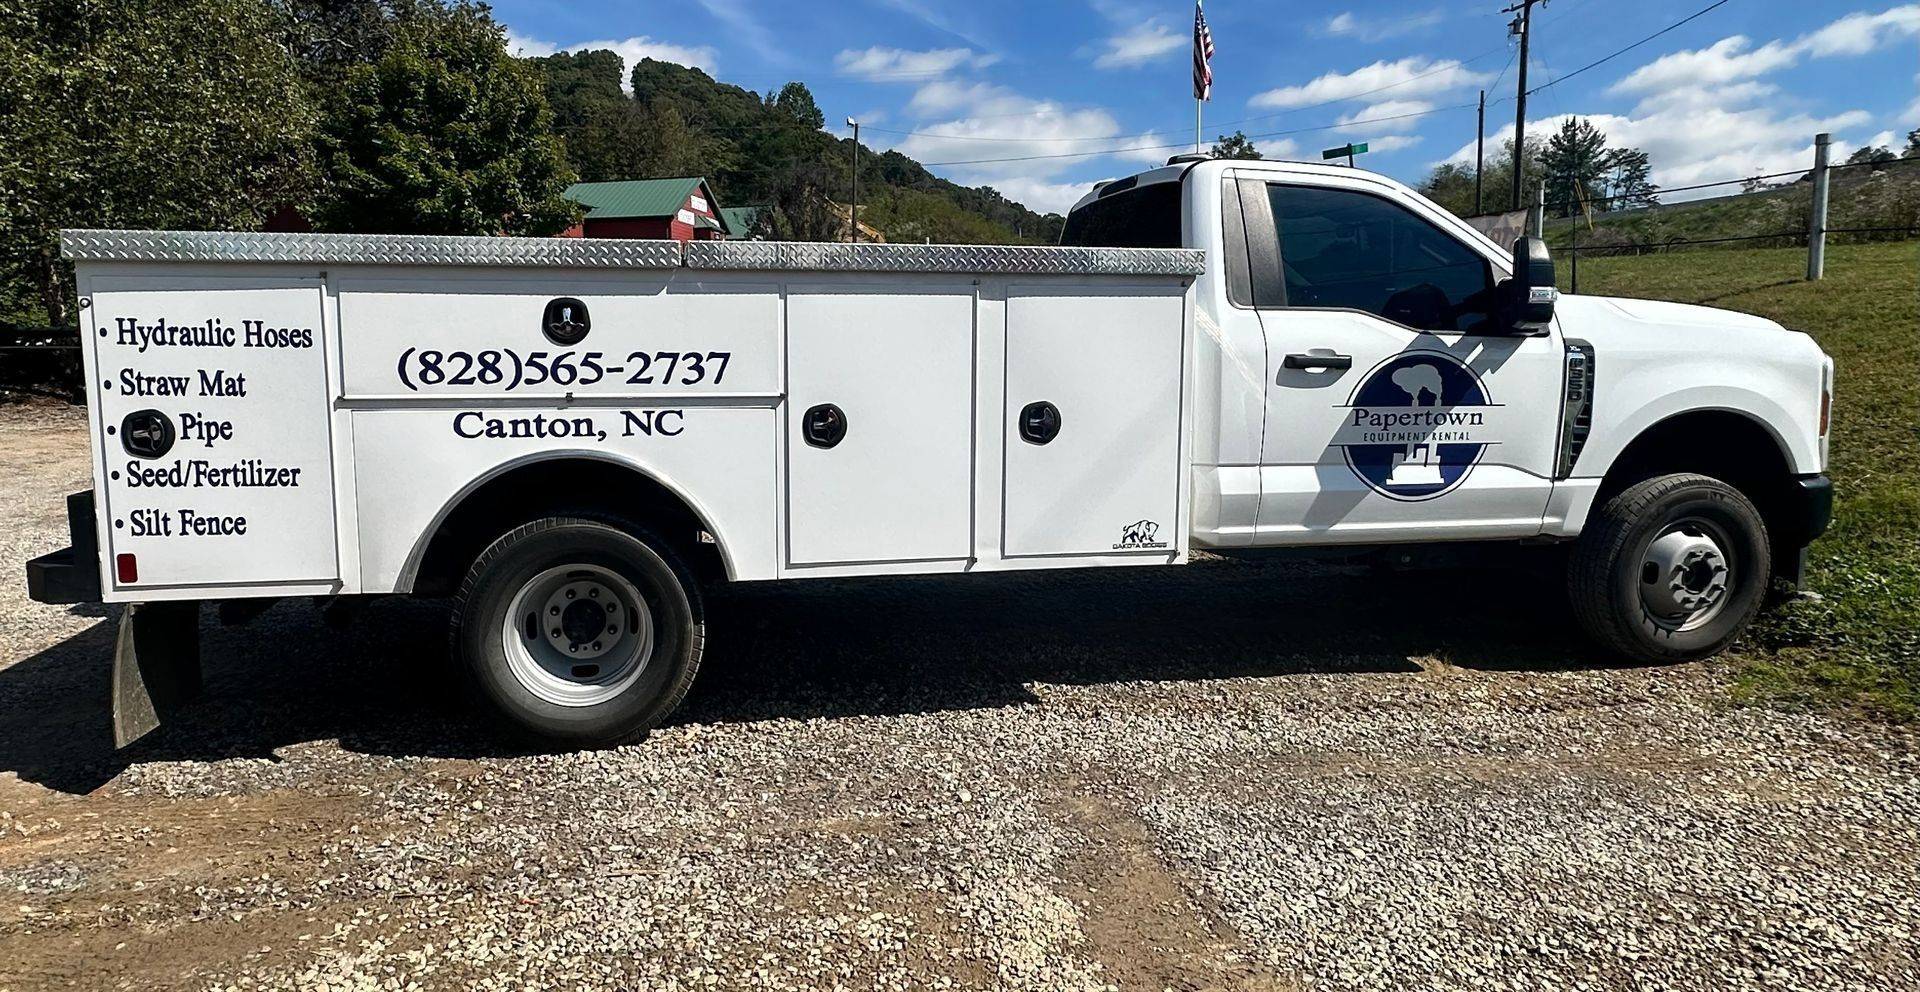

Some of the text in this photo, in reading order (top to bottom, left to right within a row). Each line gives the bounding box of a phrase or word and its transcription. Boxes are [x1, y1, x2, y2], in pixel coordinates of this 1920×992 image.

[115, 317, 313, 353] Hydraulic Hoses
[119, 368, 247, 397] Straw Mat
[397, 347, 731, 391] (828)565-2737
[179, 412, 233, 447] Pipe
[453, 409, 685, 441] Canton, NC
[1352, 408, 1484, 431] Papertown
[1363, 431, 1470, 442] EQUIPMENT RENTAL
[127, 459, 301, 488] Seed/Fertilizer
[130, 508, 247, 537] Silt Fence
